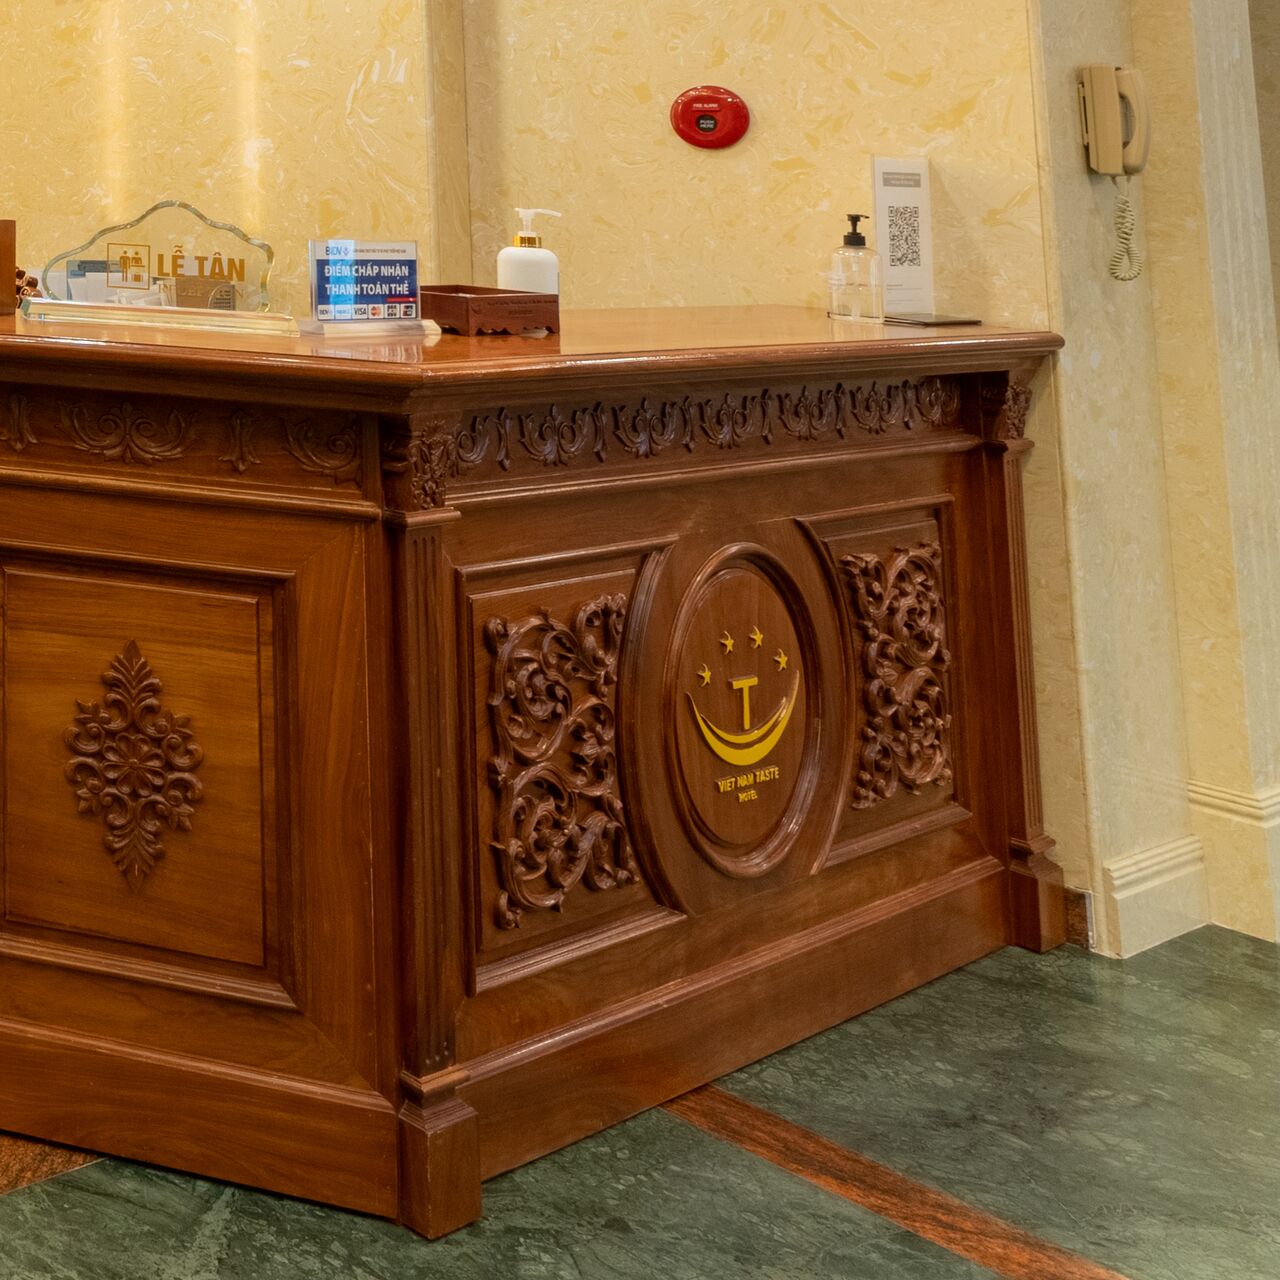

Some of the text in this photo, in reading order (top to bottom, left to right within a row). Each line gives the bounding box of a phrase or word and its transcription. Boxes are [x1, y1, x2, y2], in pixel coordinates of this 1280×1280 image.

[157, 244, 245, 282] LỄ TÂN
[352, 261, 379, 277] CHẤP
[380, 263, 409, 280] NHẬN
[325, 280, 409, 295] THANH TOÁN THẺ
[354, 307, 367, 316] VISA
[717, 777, 736, 793] VIET
[755, 766, 780, 783] TASTE
